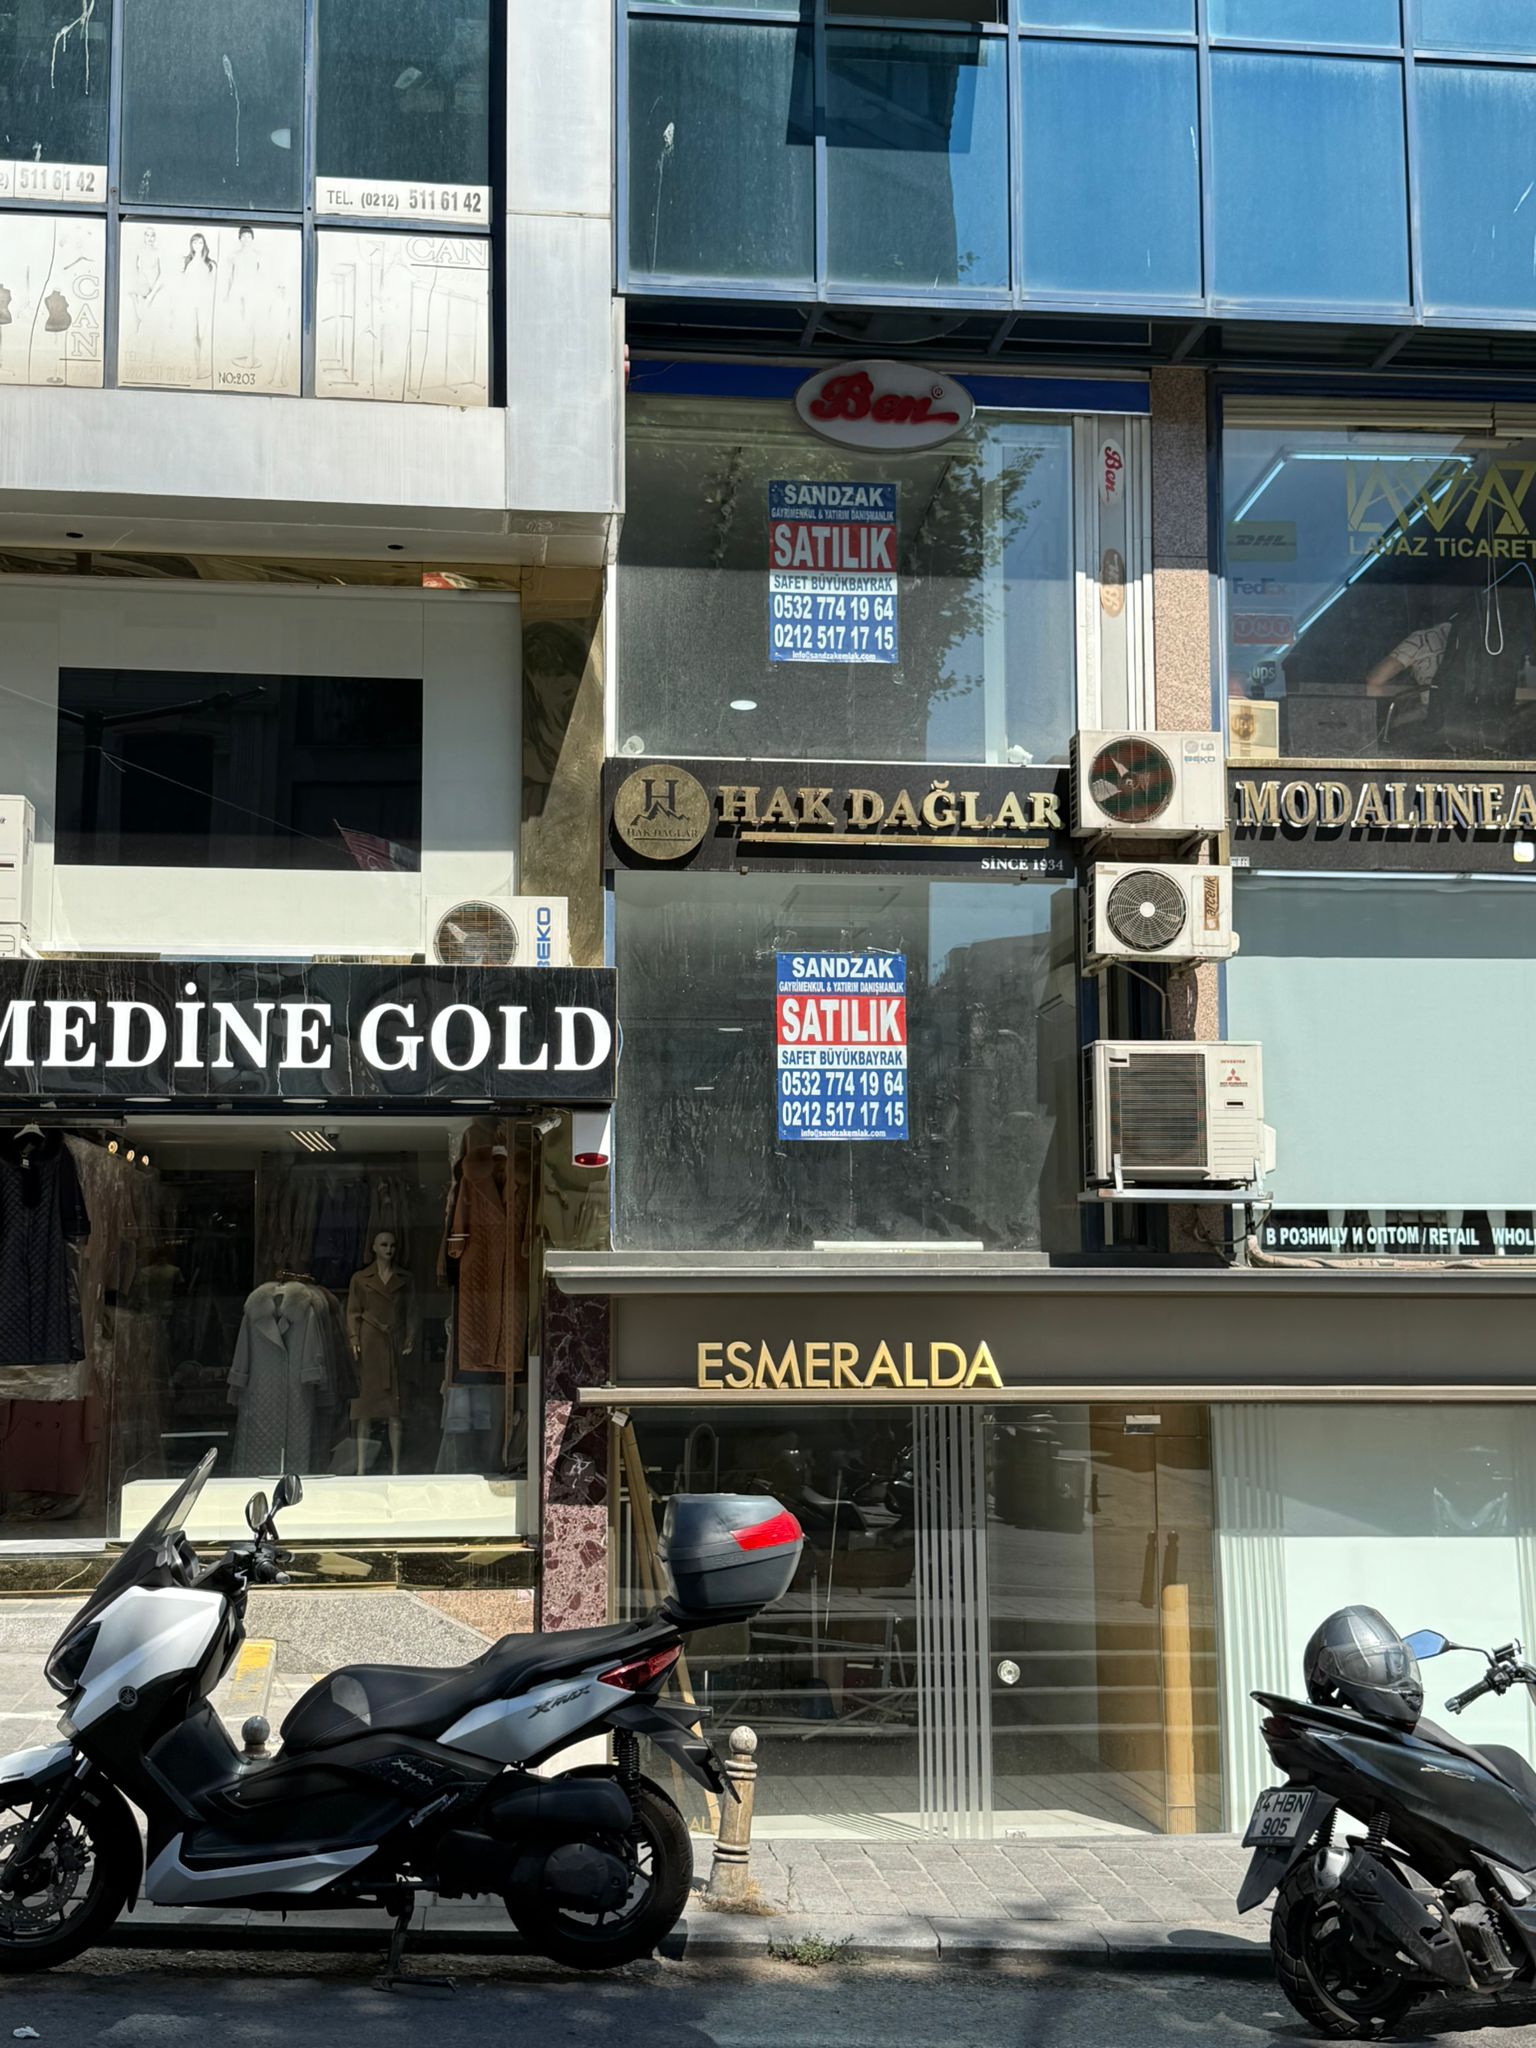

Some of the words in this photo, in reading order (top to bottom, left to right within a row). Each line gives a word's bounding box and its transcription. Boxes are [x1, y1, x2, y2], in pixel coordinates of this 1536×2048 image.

[20, 168, 47, 189] 511
[53, 170, 71, 191] 61
[76, 171, 95, 192] 42
[327, 190, 353, 206] TEL.
[361, 192, 399, 211] (0212)
[409, 189, 435, 210] 511
[441, 191, 458, 211] 61
[463, 192, 481, 213] 42
[407, 236, 487, 266] CAN
[218, 372, 256, 385] NO:203
[784, 484, 884, 507] SANDZAK
[774, 524, 892, 569] SATILIK
[1236, 534, 1286, 546] DHL
[774, 575, 808, 589] SAFET
[812, 573, 893, 591] BÜYÜKBAYRAK
[1232, 577, 1286, 595] FedEx
[774, 594, 812, 619] 0532
[817, 596, 846, 620] 774
[850, 597, 869, 621] 19
[874, 597, 894, 621] 64
[774, 623, 812, 648] 0212
[817, 625, 846, 649] 517
[850, 625, 869, 650] 17
[874, 625, 894, 650] 15
[718, 785, 837, 825] HAK
[848, 779, 1066, 831] DAĞLAR
[1236, 780, 1536, 830] MODALINEA
[981, 856, 1029, 870] SİNCE
[1033, 858, 1064, 871] 1934
[792, 957, 894, 978] SANDZAK
[782, 998, 903, 1042] SATILIK
[360, 1002, 612, 1073] GOLD
[782, 1050, 816, 1065] SAFET
[820, 1048, 903, 1065] BÜYÜKBAYRAK
[782, 1071, 821, 1096] 0532
[826, 1071, 855, 1096] 774
[860, 1071, 879, 1096] 19
[884, 1071, 904, 1096] 64
[782, 1101, 821, 1126] 0212
[826, 1101, 855, 1126] 517
[860, 1101, 879, 1126] 17
[885, 1101, 904, 1126] 15
[1266, 1228, 1276, 1245] В
[1280, 1227, 1348, 1247] РОЗНИЦУ
[1352, 1227, 1363, 1244] И
[1367, 1226, 1419, 1244] ОПТОМ
[1429, 1227, 1480, 1246] RETAIL
[1491, 1227, 1536, 1246] WHOL
[698, 1339, 1004, 1388] ESMERALDA
[1272, 1794, 1309, 1813] HBN
[1261, 1817, 1291, 1836] 905
